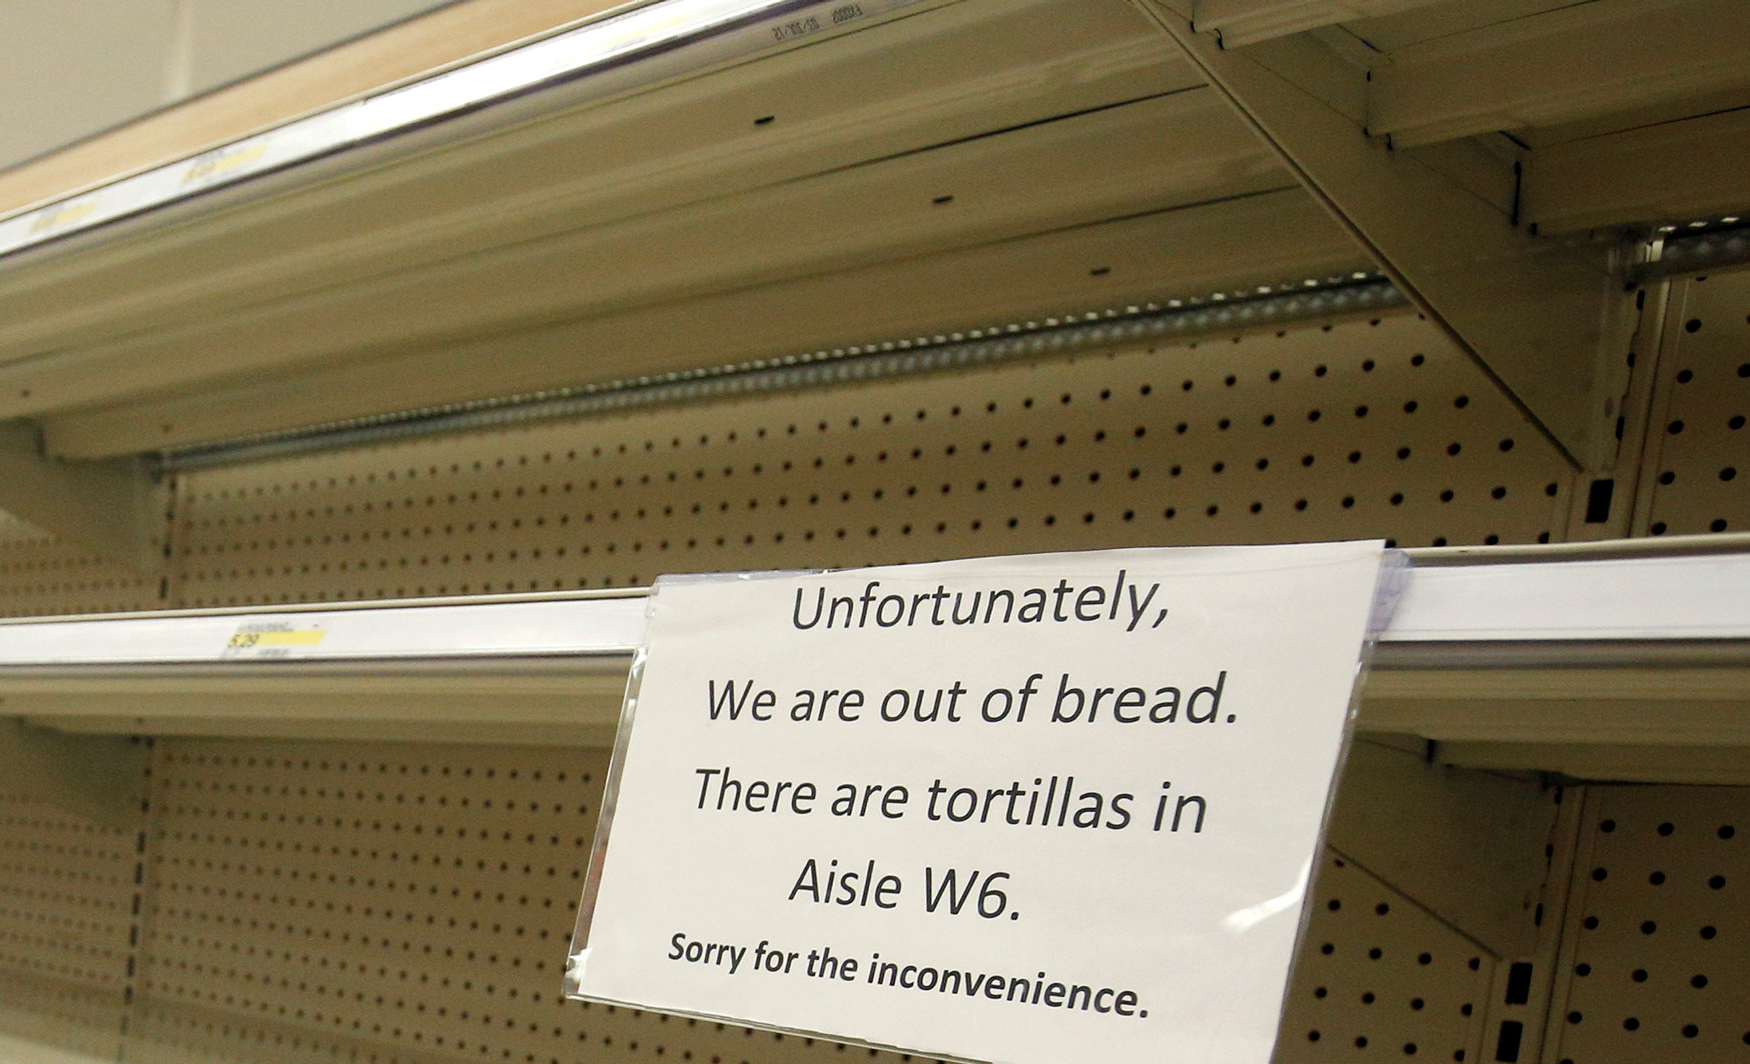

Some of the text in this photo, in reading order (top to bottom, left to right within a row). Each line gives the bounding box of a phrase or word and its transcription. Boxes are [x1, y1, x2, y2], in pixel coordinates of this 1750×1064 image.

[790, 568, 1169, 633] Unfortunately,
[706, 670, 1237, 724] We are out of bread.
[694, 766, 1207, 834] There are tortillas in
[788, 858, 1020, 921] Aisle W6.
[667, 932, 1149, 1019] Sorry for the inconvenience.
